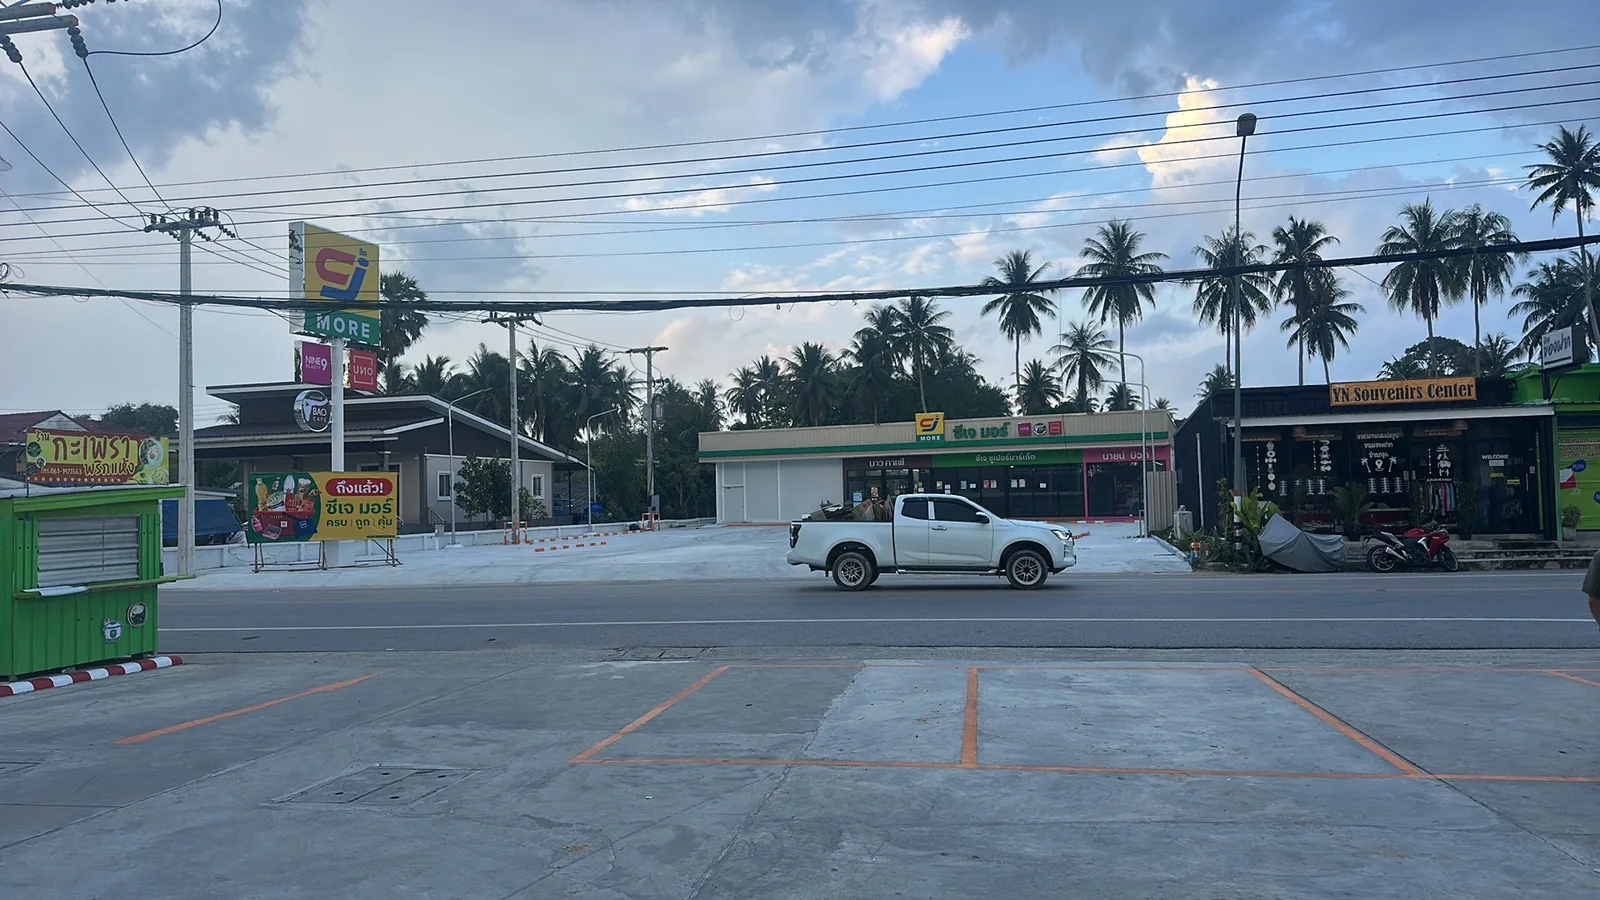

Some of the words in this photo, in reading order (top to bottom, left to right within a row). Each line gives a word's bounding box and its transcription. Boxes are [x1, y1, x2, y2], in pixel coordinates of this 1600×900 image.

[316, 312, 370, 338] MORE
[1332, 387, 1350, 402] YN
[1354, 384, 1423, 402] Souvenirs
[1428, 382, 1474, 399] Center
[312, 406, 328, 417] BAO
[36, 430, 50, 442] ร้าน
[953, 424, 977, 440] ซีเจ
[980, 421, 1011, 439] มอร์
[52, 435, 131, 461] กะเพรา
[1102, 450, 1125, 460] นายน์
[83, 457, 135, 477] พริกแห้ง
[869, 459, 884, 467] บาว
[335, 479, 384, 494] ถึงแล้ว!
[325, 498, 355, 515] ซีเจ
[359, 498, 393, 515] มอร์
[326, 518, 348, 527] ครบ
[355, 518, 370, 530] ถูก
[378, 515, 393, 530] คุ้ม
